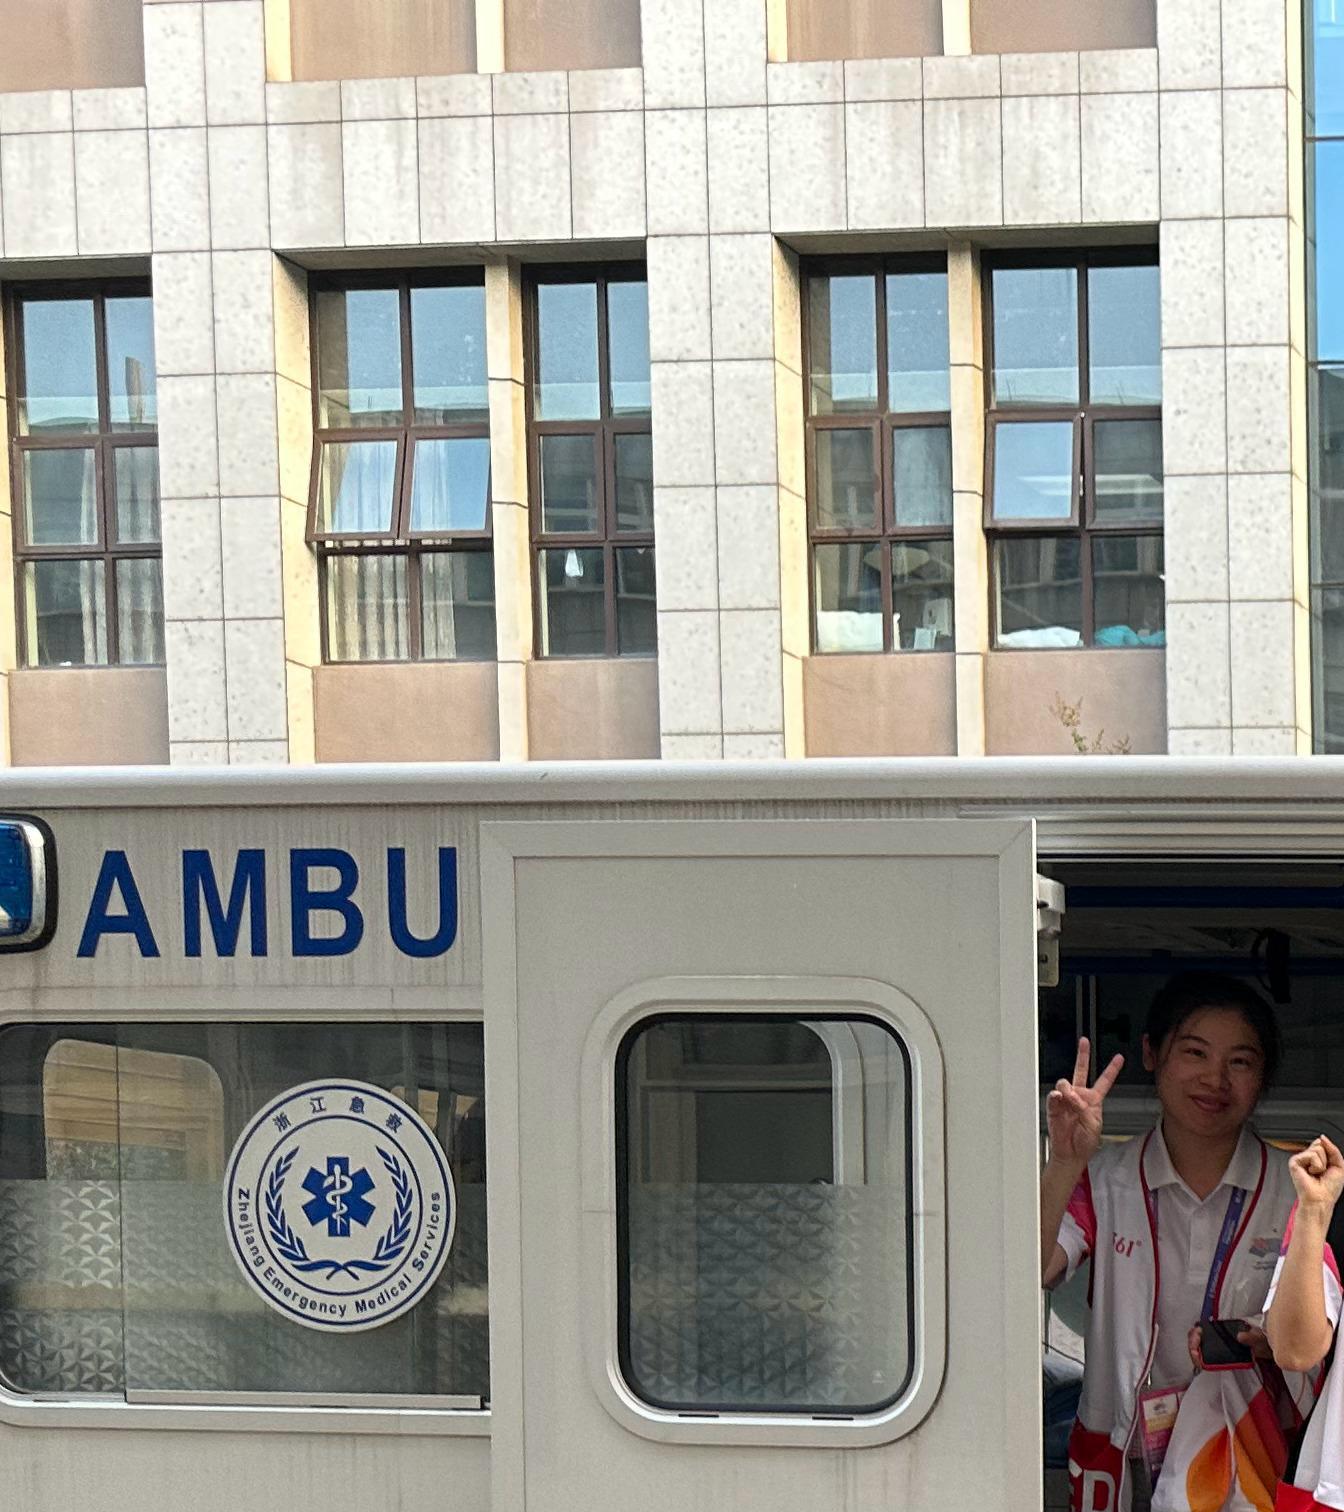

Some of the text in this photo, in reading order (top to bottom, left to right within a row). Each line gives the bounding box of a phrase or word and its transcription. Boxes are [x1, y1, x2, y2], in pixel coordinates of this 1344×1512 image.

[76, 846, 459, 958] AMBU
[238, 1188, 441, 1317] Zhejiang Emergency Medical Services
